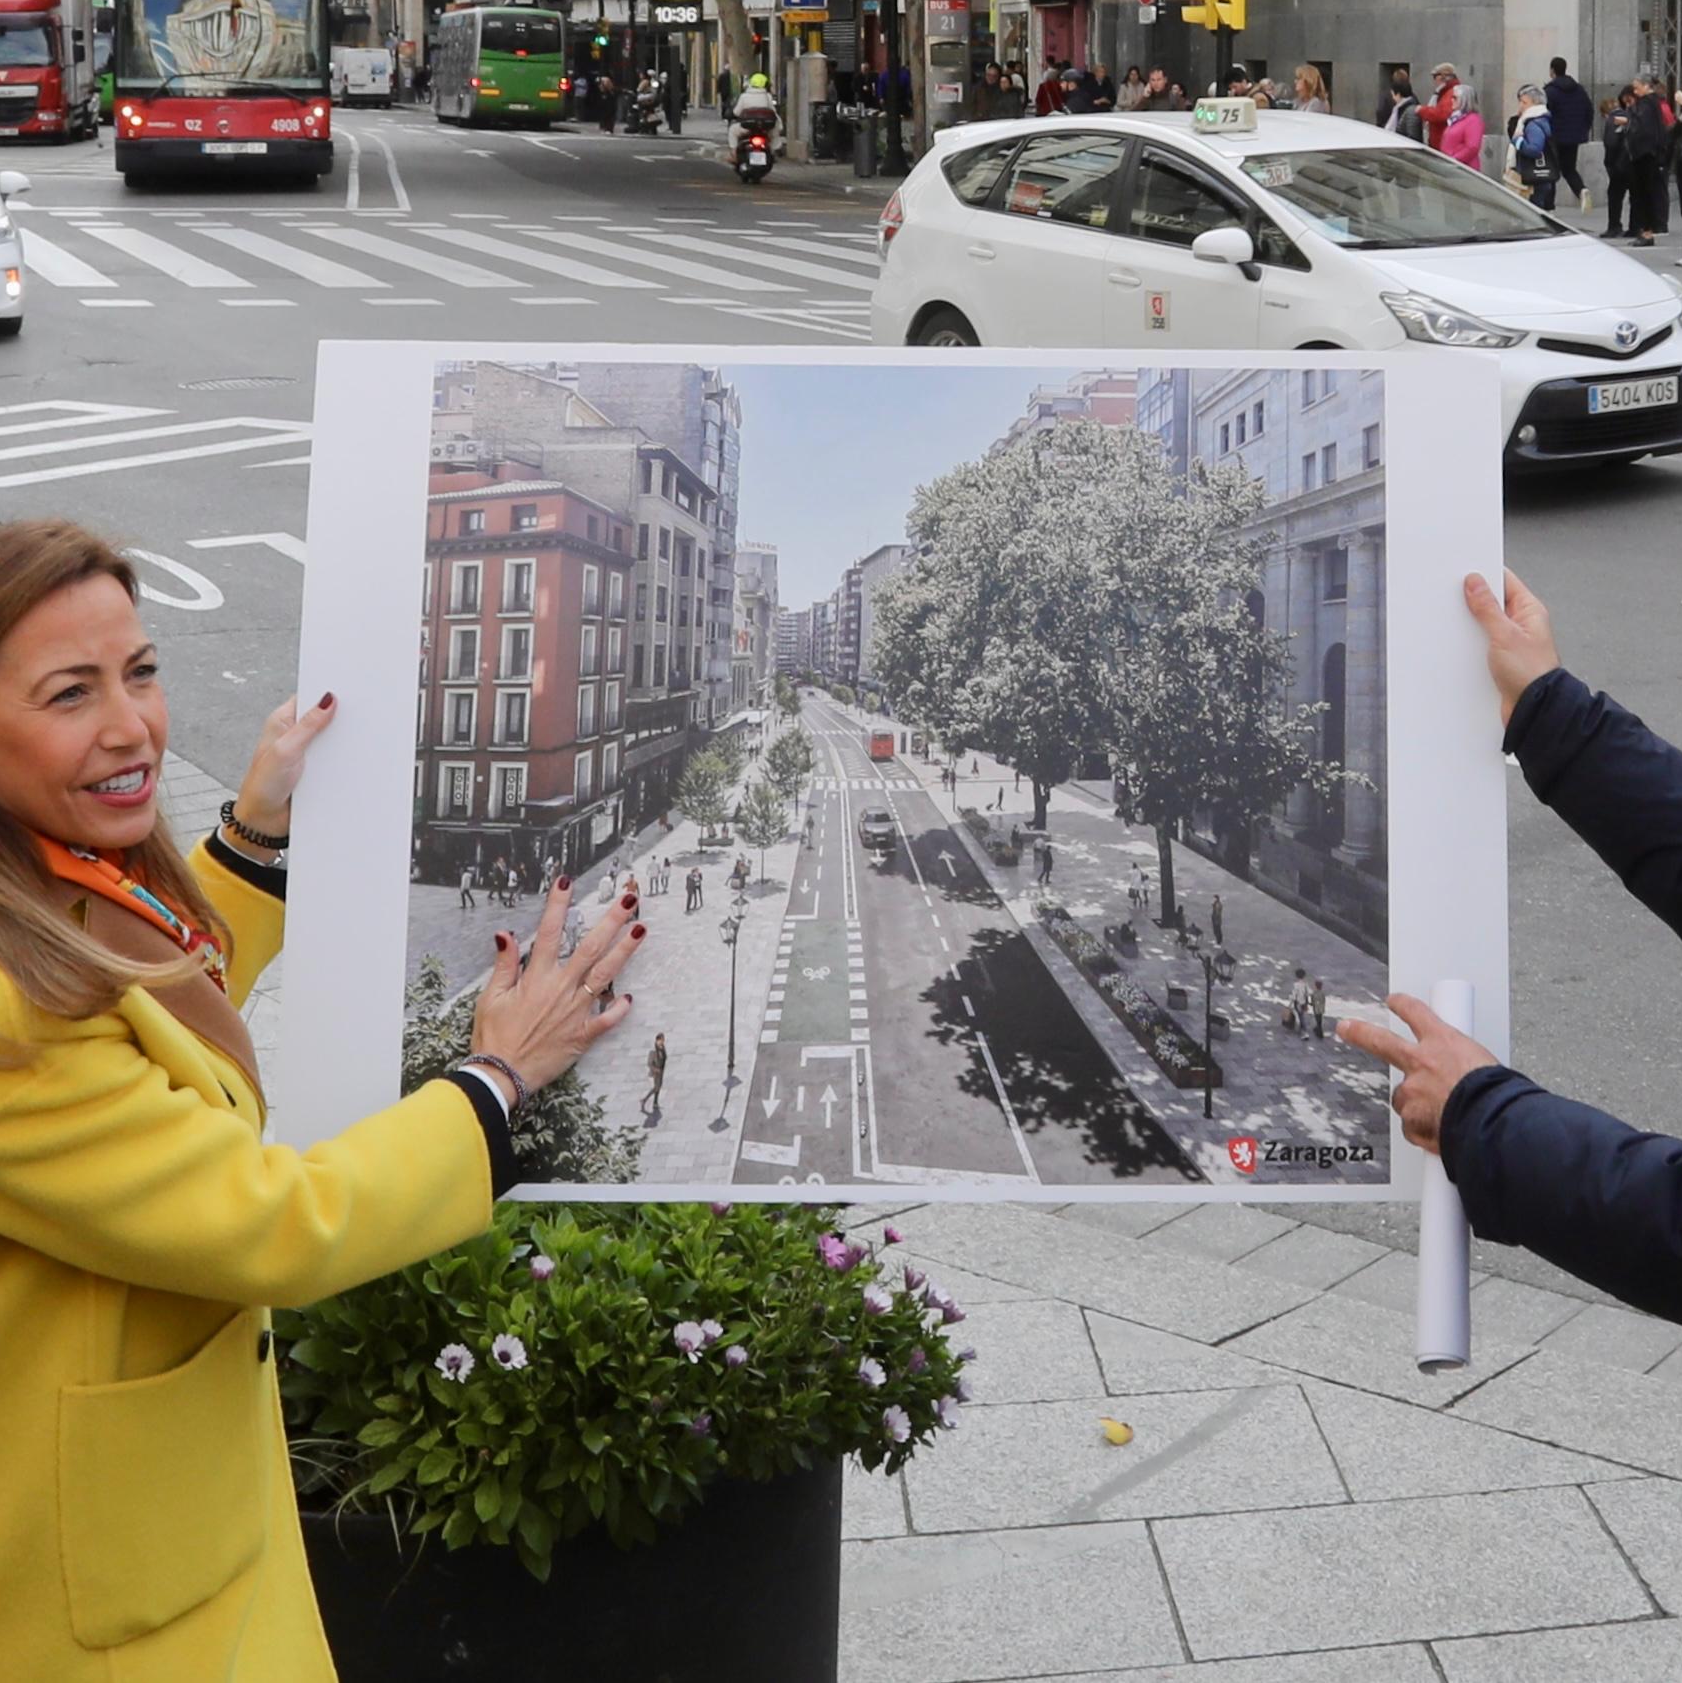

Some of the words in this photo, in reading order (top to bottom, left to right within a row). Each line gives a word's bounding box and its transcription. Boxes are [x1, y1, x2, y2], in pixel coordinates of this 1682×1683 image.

[929, 0, 950, 10] BUS
[654, 6, 698, 23] 10:36
[940, 16, 956, 30] 21
[1221, 108, 1240, 123] 75
[1600, 386, 1640, 409] 5404
[1646, 381, 1674, 403] KDS
[1264, 1141, 1374, 1169] Zaragoza
